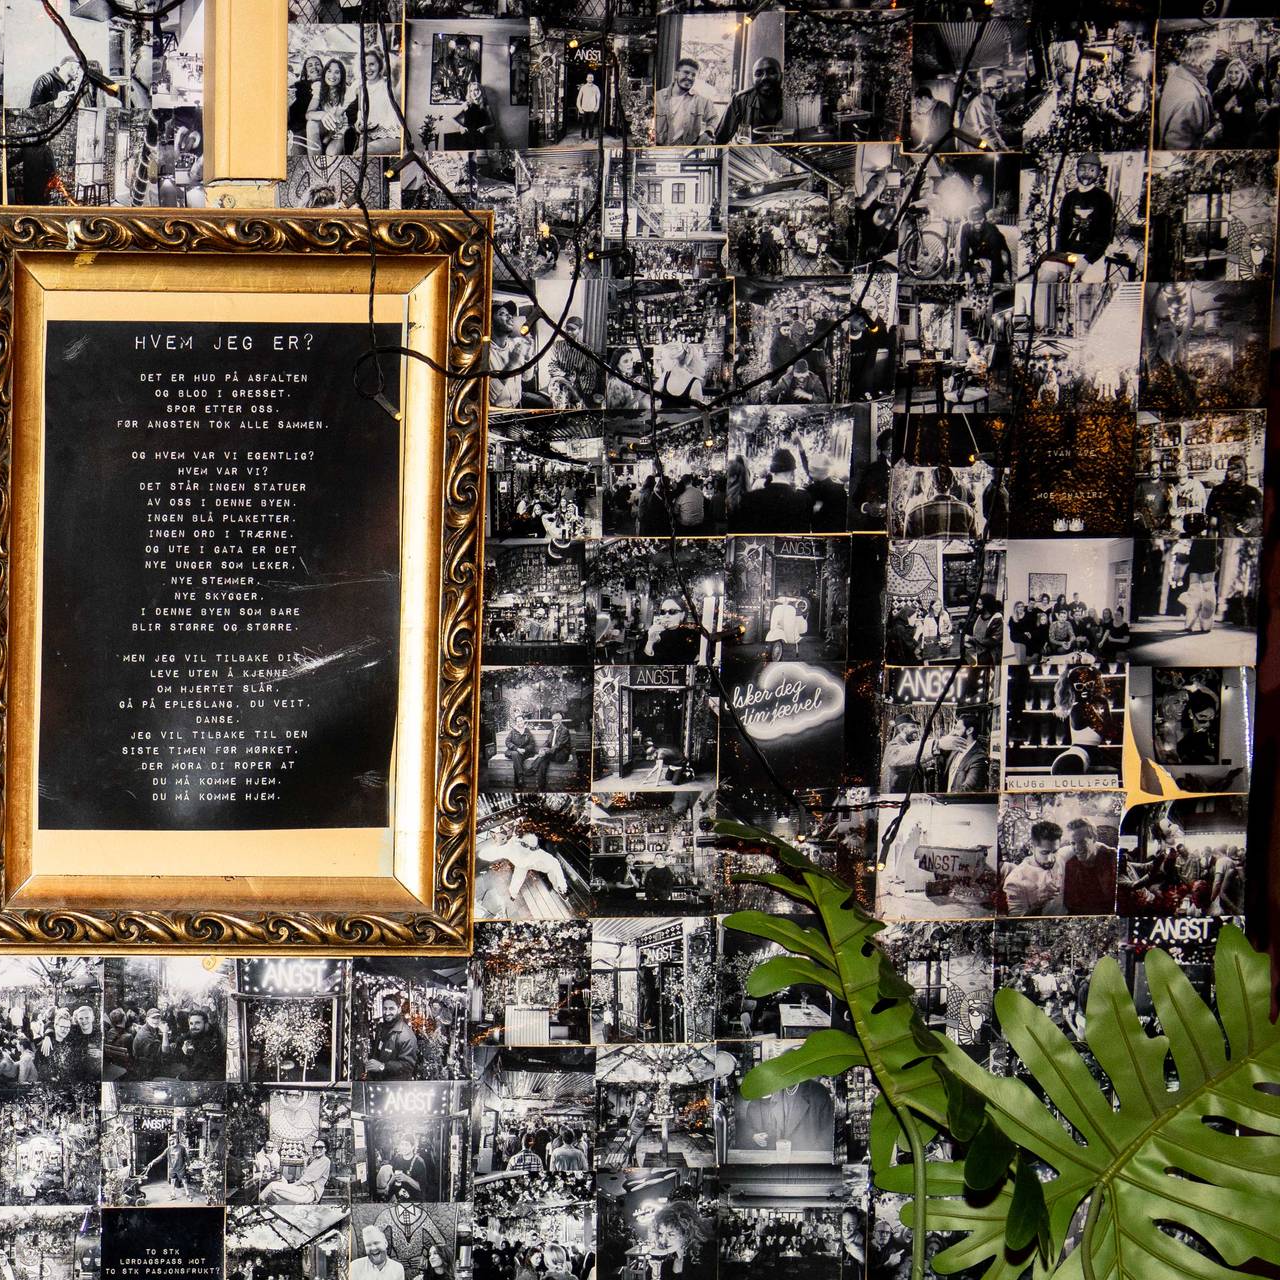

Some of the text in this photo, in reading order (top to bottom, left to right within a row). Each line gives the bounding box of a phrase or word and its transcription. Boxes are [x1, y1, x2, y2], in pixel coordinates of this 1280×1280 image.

[135, 332, 314, 351] HVEM JEG ER?
[140, 370, 308, 383] DET ER HUD PÅ ASFALTEN
[116, 419, 139, 429] FØR
[147, 419, 200, 429] ANGSTEN
[208, 419, 231, 430] TOK
[239, 420, 270, 430] ALLE
[139, 479, 307, 492] DET STÅR INGEN STATUER
[147, 513, 184, 523] INGEN
[191, 511, 214, 523] BLÅ
[148, 529, 185, 539] INGEN
[193, 529, 216, 539] ORD
[224, 529, 230, 539] I
[131, 622, 162, 632] BLIR
[169, 622, 215, 632] STØRRE
[222, 623, 238, 632] OG
[637, 669, 679, 685] ANGST
[897, 669, 969, 698] ANGST
[141, 760, 295, 771] DER MORA DI ROPER AT
[1148, 917, 1215, 940] ANGST
[261, 961, 328, 989] ANGST
[383, 1090, 436, 1112] ANGST
[145, 1248, 180, 1256] TO STK
[188, 1257, 206, 1265] MOT
